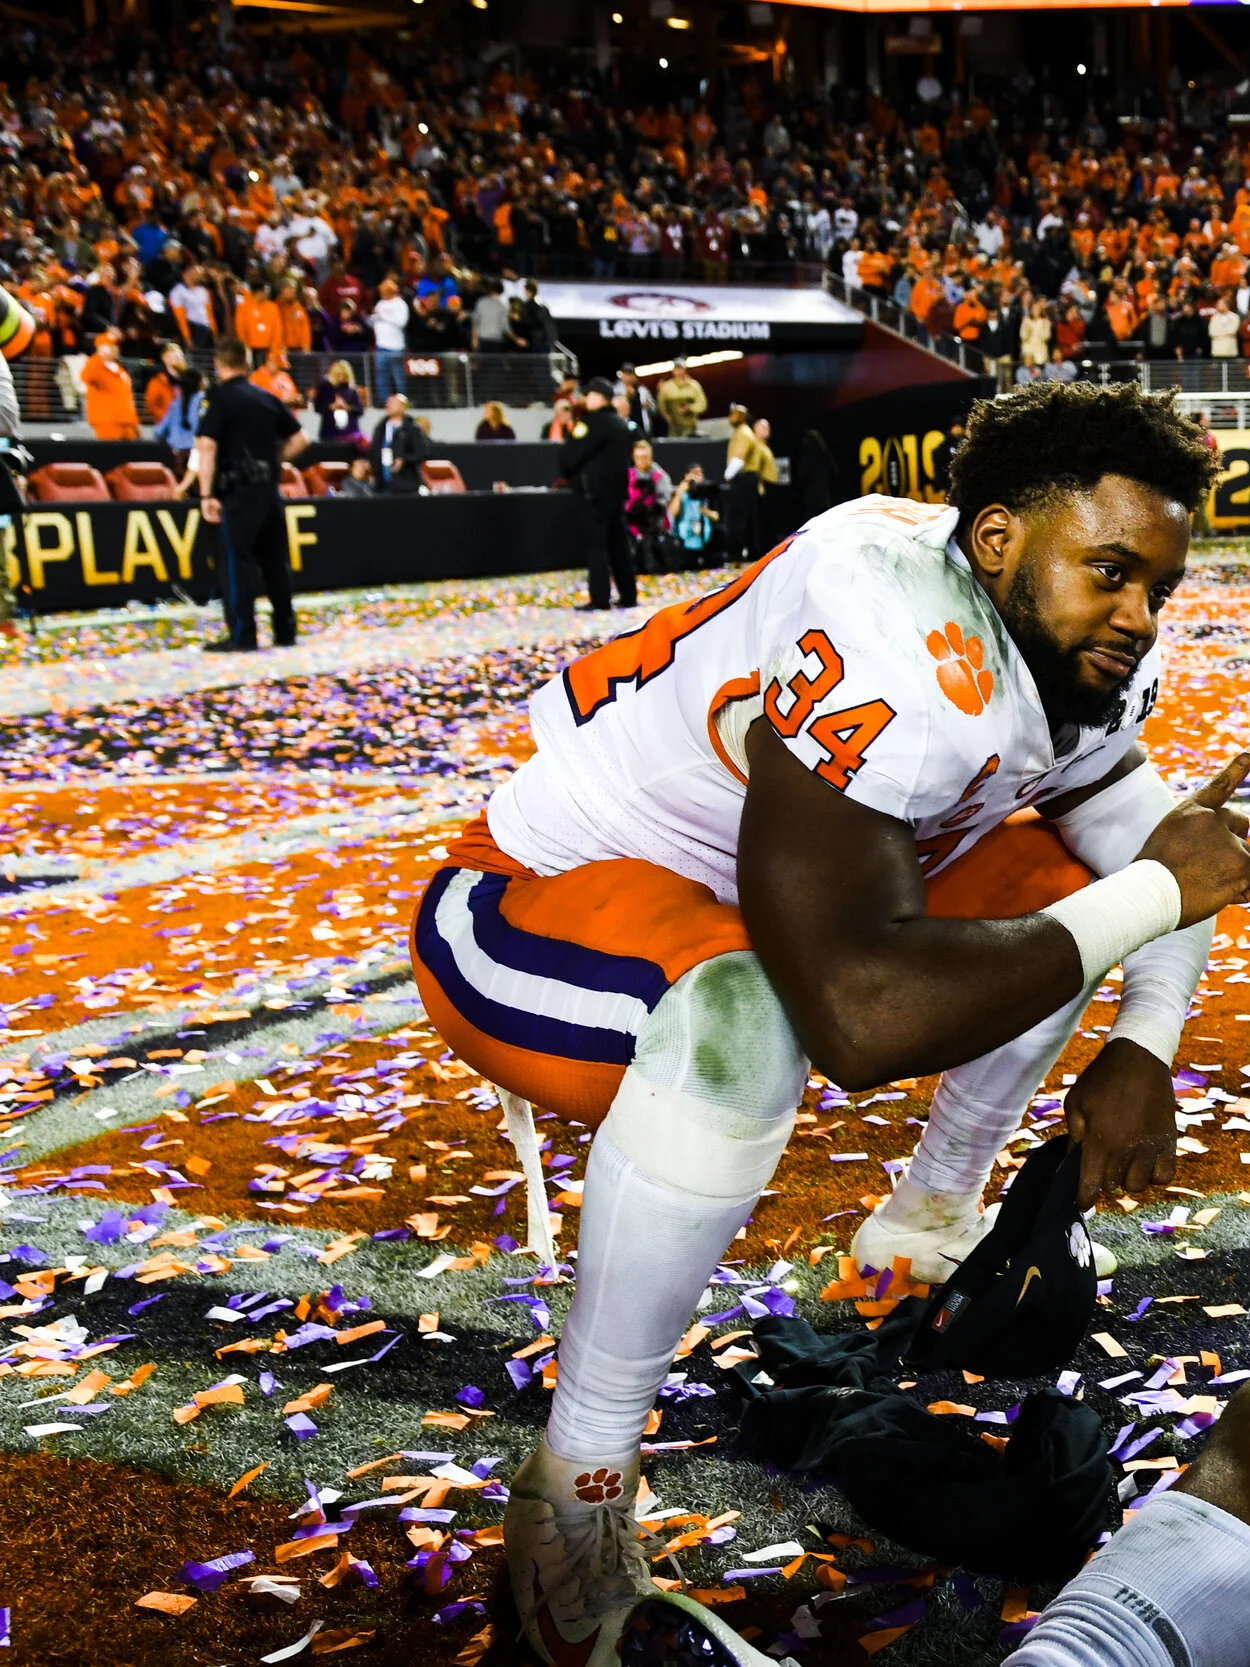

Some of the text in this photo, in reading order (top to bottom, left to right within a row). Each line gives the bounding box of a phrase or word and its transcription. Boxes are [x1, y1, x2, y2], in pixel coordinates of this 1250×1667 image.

[681, 320, 771, 340] STADIUM
[23, 504, 319, 590] PLAYF
[763, 628, 898, 793] 34
